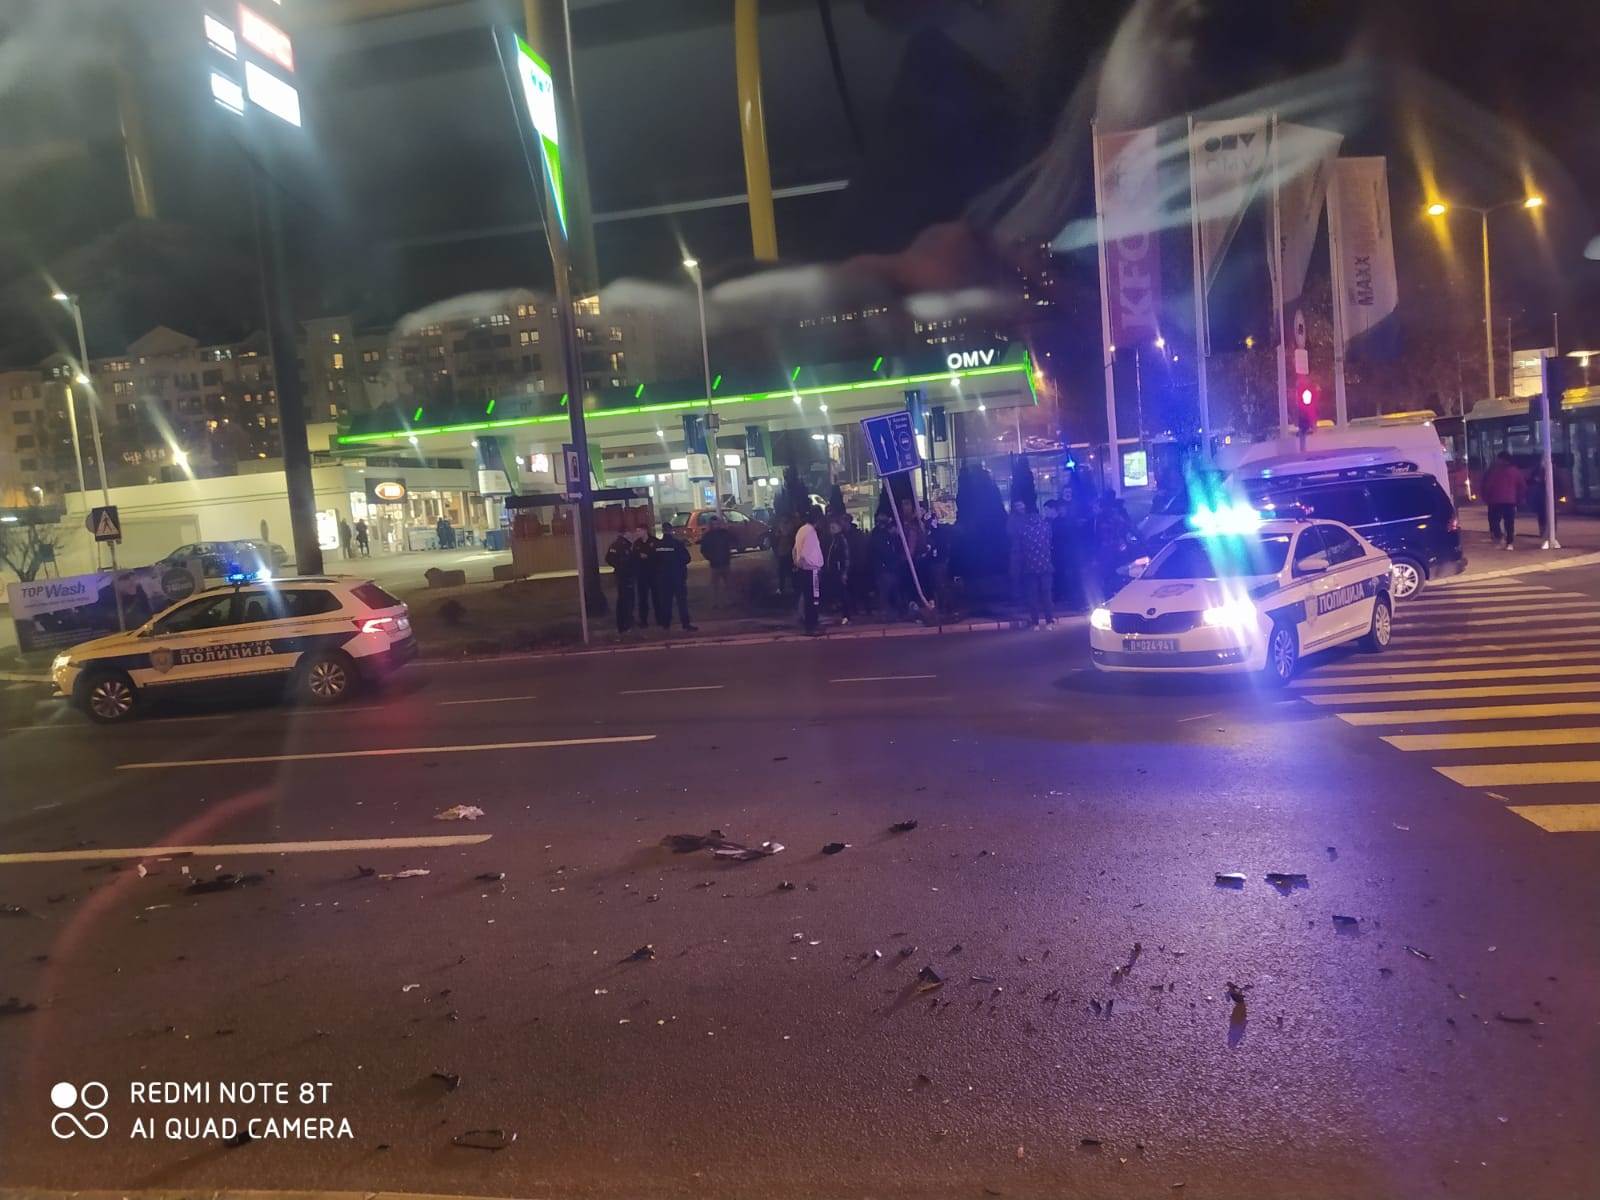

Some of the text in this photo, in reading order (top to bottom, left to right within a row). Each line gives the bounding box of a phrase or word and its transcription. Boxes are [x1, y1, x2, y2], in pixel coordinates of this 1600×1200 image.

[1354, 256, 1374, 306] MAXX
[947, 348, 995, 369] OMV
[1319, 583, 1365, 613] ПОЛИЦИЈА
[180, 646, 275, 664] ПОЛИЦИЈА
